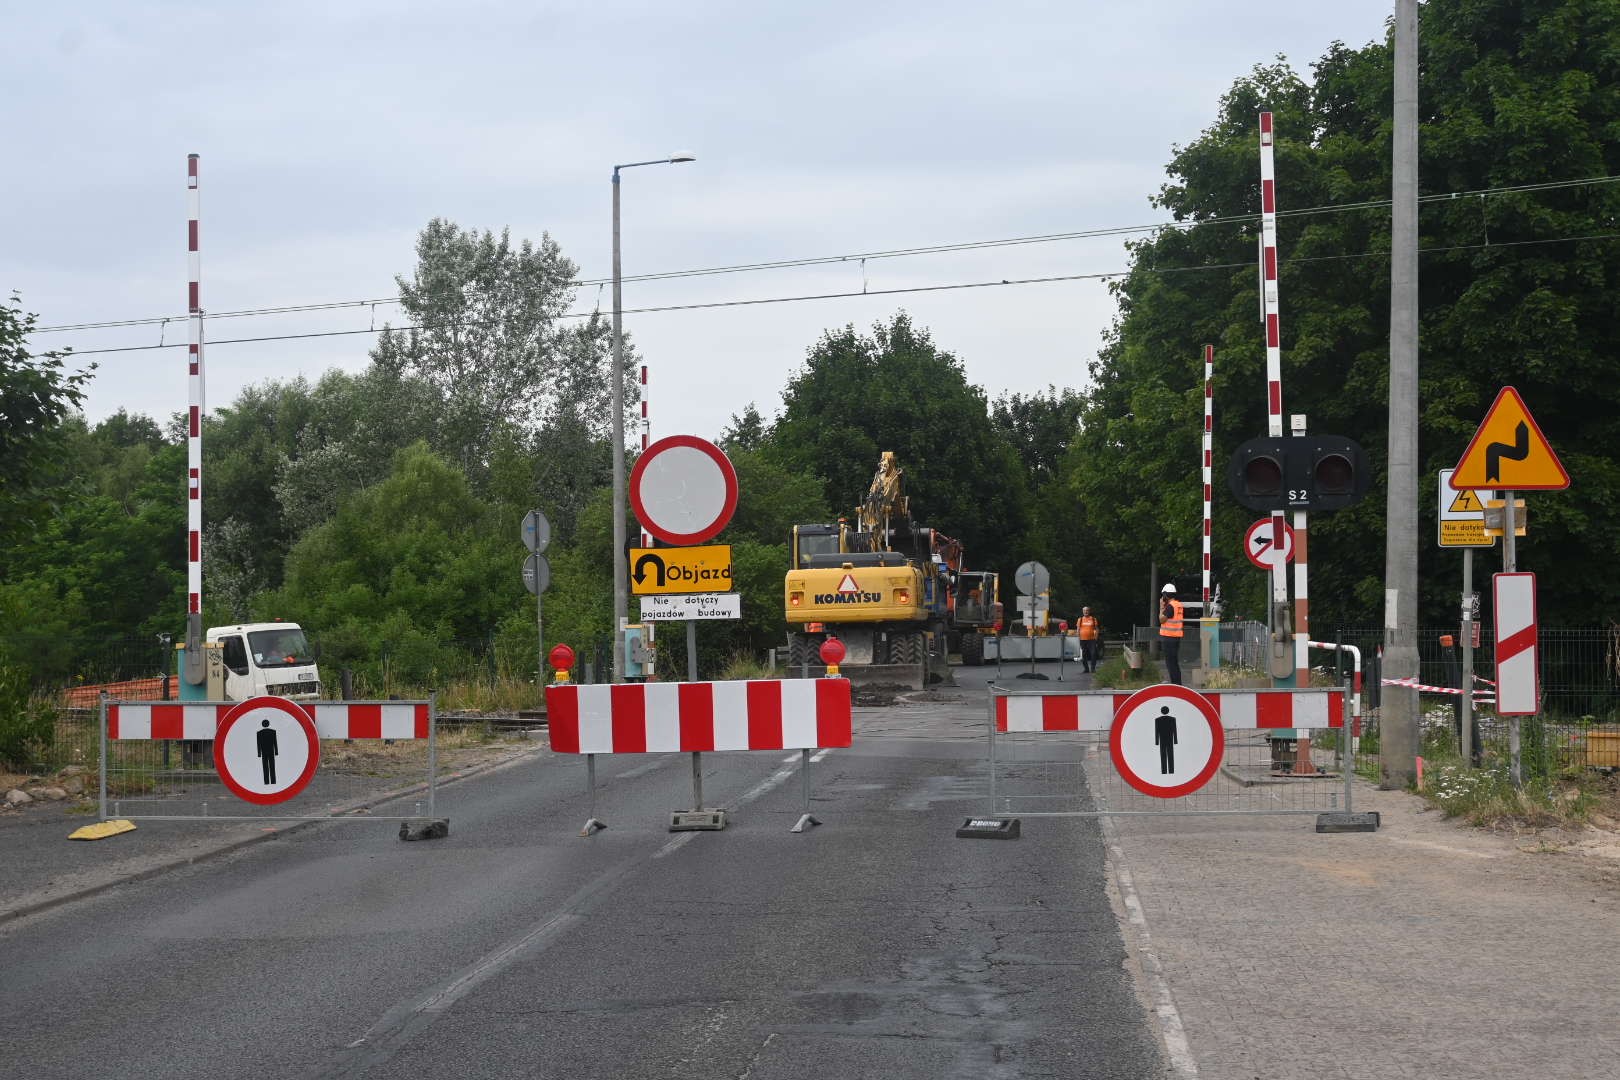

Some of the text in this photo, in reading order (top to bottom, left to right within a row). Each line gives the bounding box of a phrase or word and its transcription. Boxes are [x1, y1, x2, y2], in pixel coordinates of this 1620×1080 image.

[666, 564, 731, 584] Objazd
[653, 597, 719, 606] Nie dotyczy
[815, 591, 881, 604] KOMATSU
[641, 608, 732, 620] pojazdów budowy
